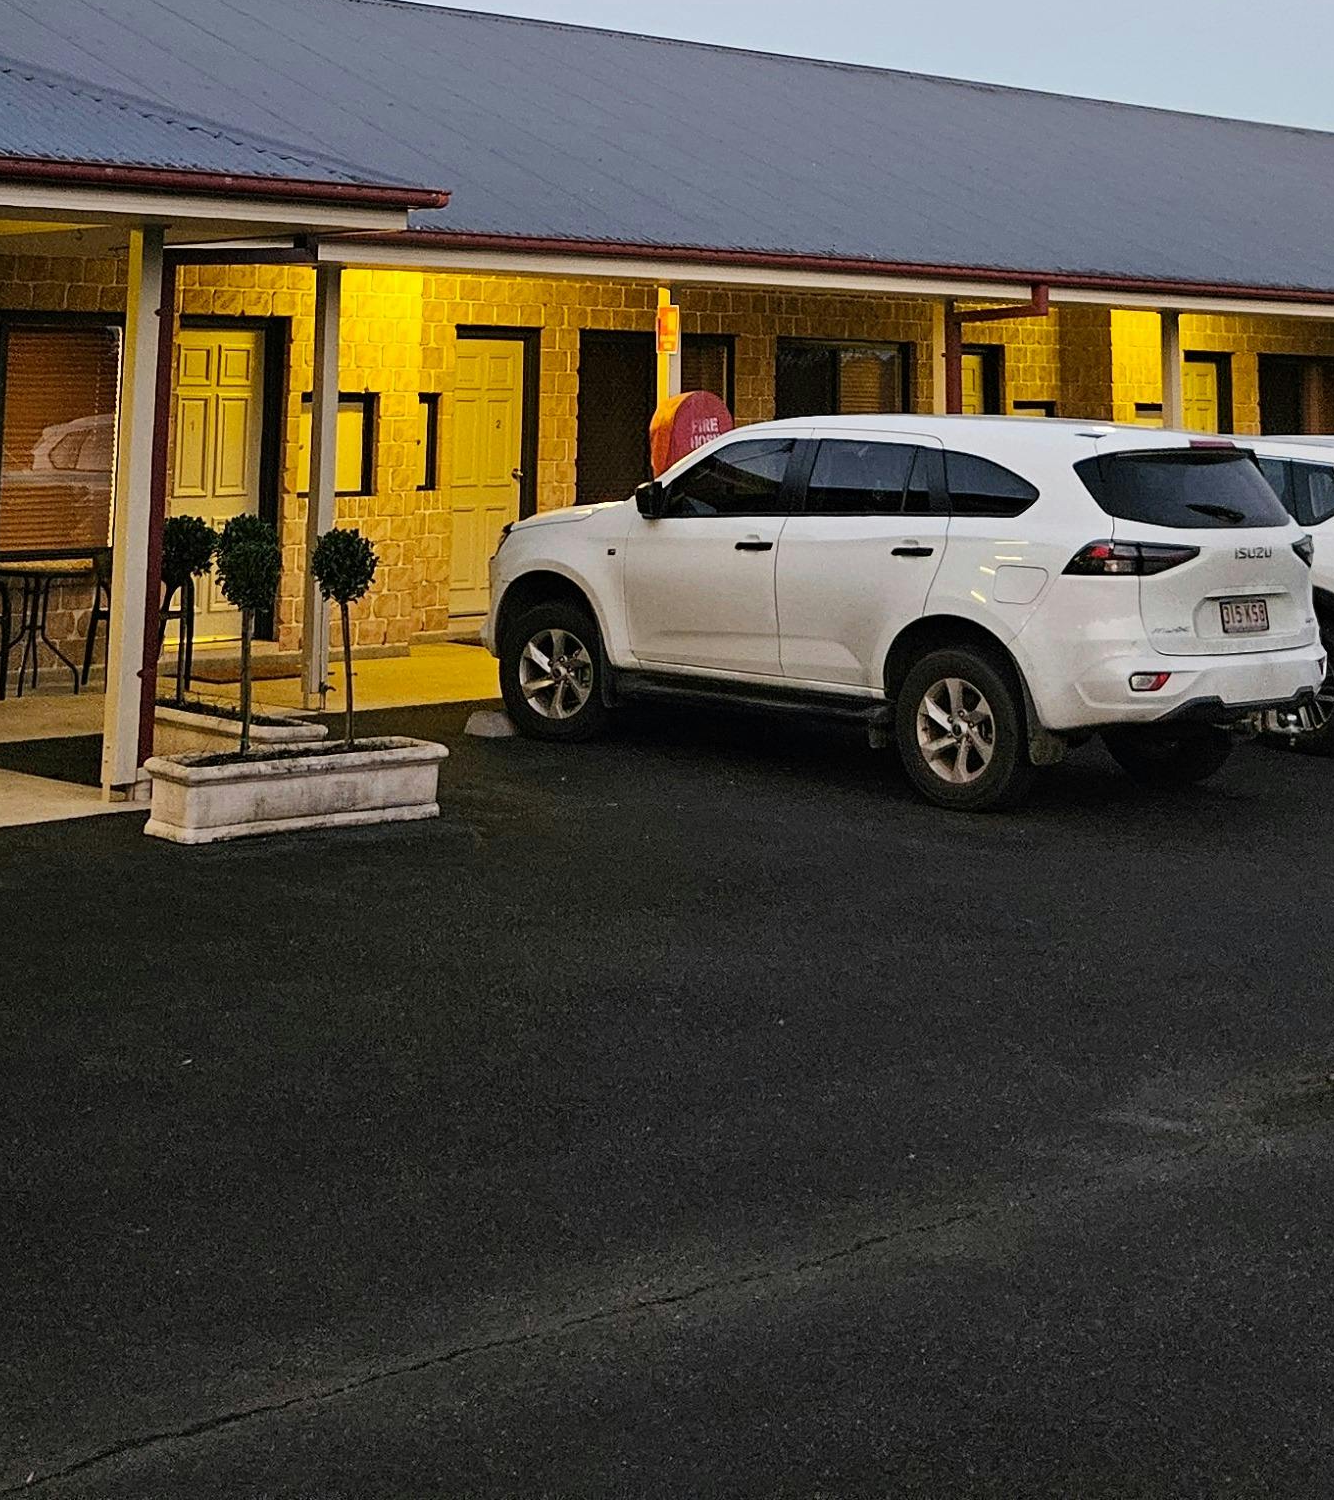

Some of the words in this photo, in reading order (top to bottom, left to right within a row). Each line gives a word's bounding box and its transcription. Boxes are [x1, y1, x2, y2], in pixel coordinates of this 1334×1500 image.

[496, 419, 501, 429] 2
[691, 417, 718, 434] FIRE
[1234, 546, 1272, 560] ISUZU
